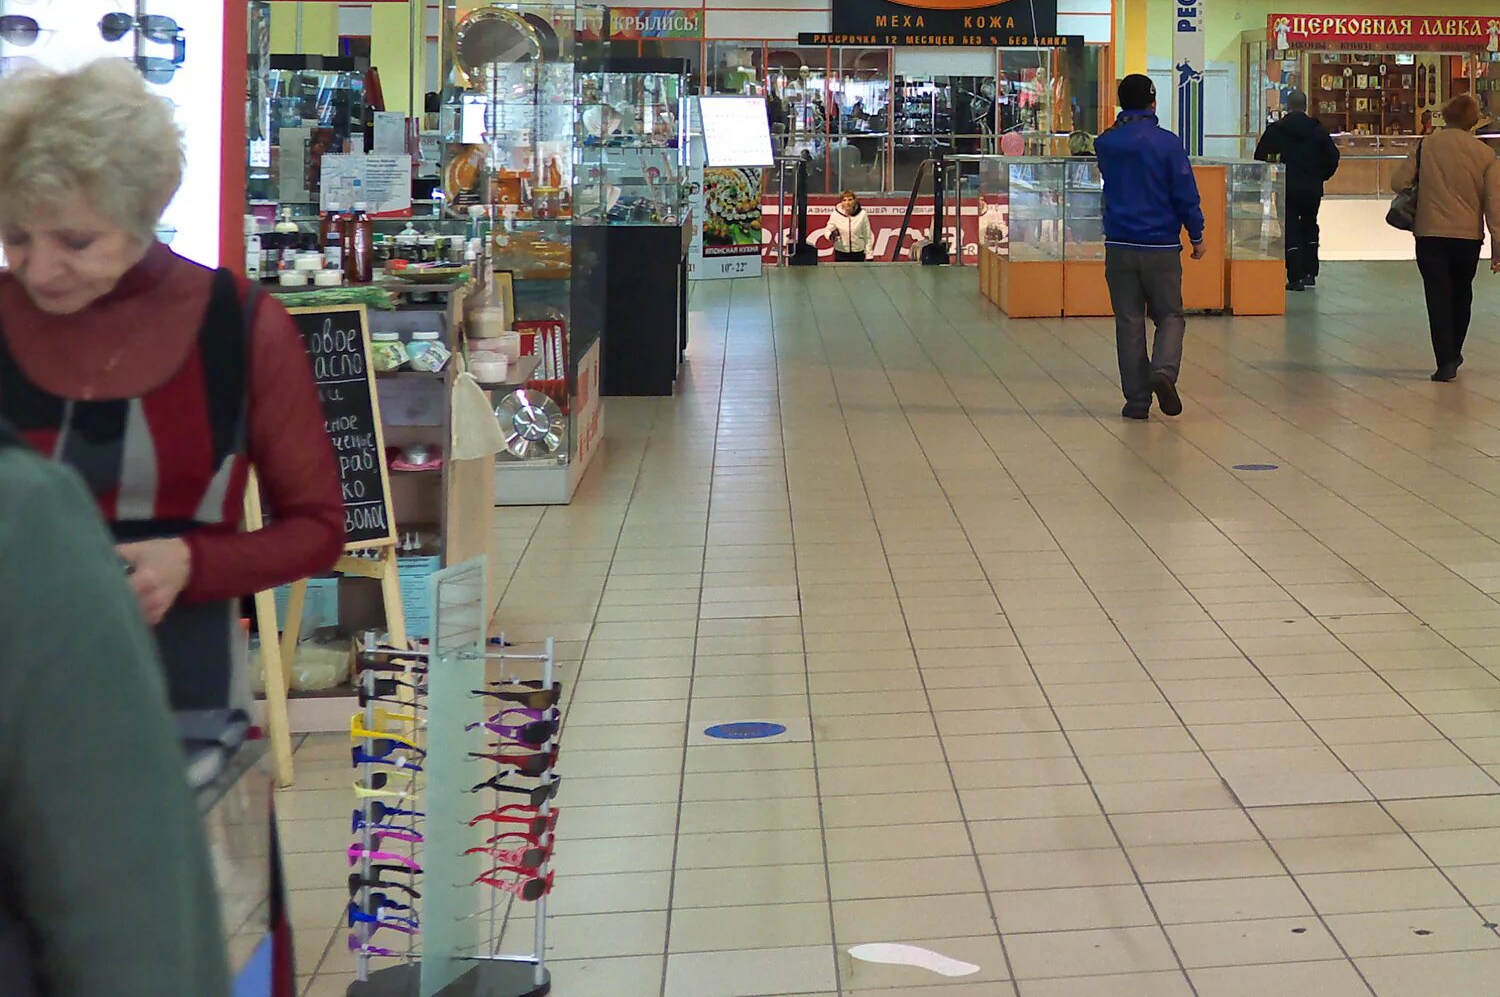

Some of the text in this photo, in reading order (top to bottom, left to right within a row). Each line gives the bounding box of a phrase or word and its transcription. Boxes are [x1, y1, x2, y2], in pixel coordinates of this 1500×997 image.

[876, 15, 1015, 28] МЕХА КОЖА
[1293, 17, 1482, 38] ЦЕРКОВНАЯ ЛАВКА
[814, 34, 876, 44] РАССРОЧКА
[885, 35, 897, 44] 12
[906, 35, 955, 45] МЕСЯЦЕВ
[963, 36, 982, 45] БЕЗ
[1009, 36, 1028, 45] БЕЗ
[1033, 36, 1067, 45] БАНКА
[705, 245, 759, 255] ЯПОНСКАЯ КУХНЯ
[314, 353, 363, 379] асло
